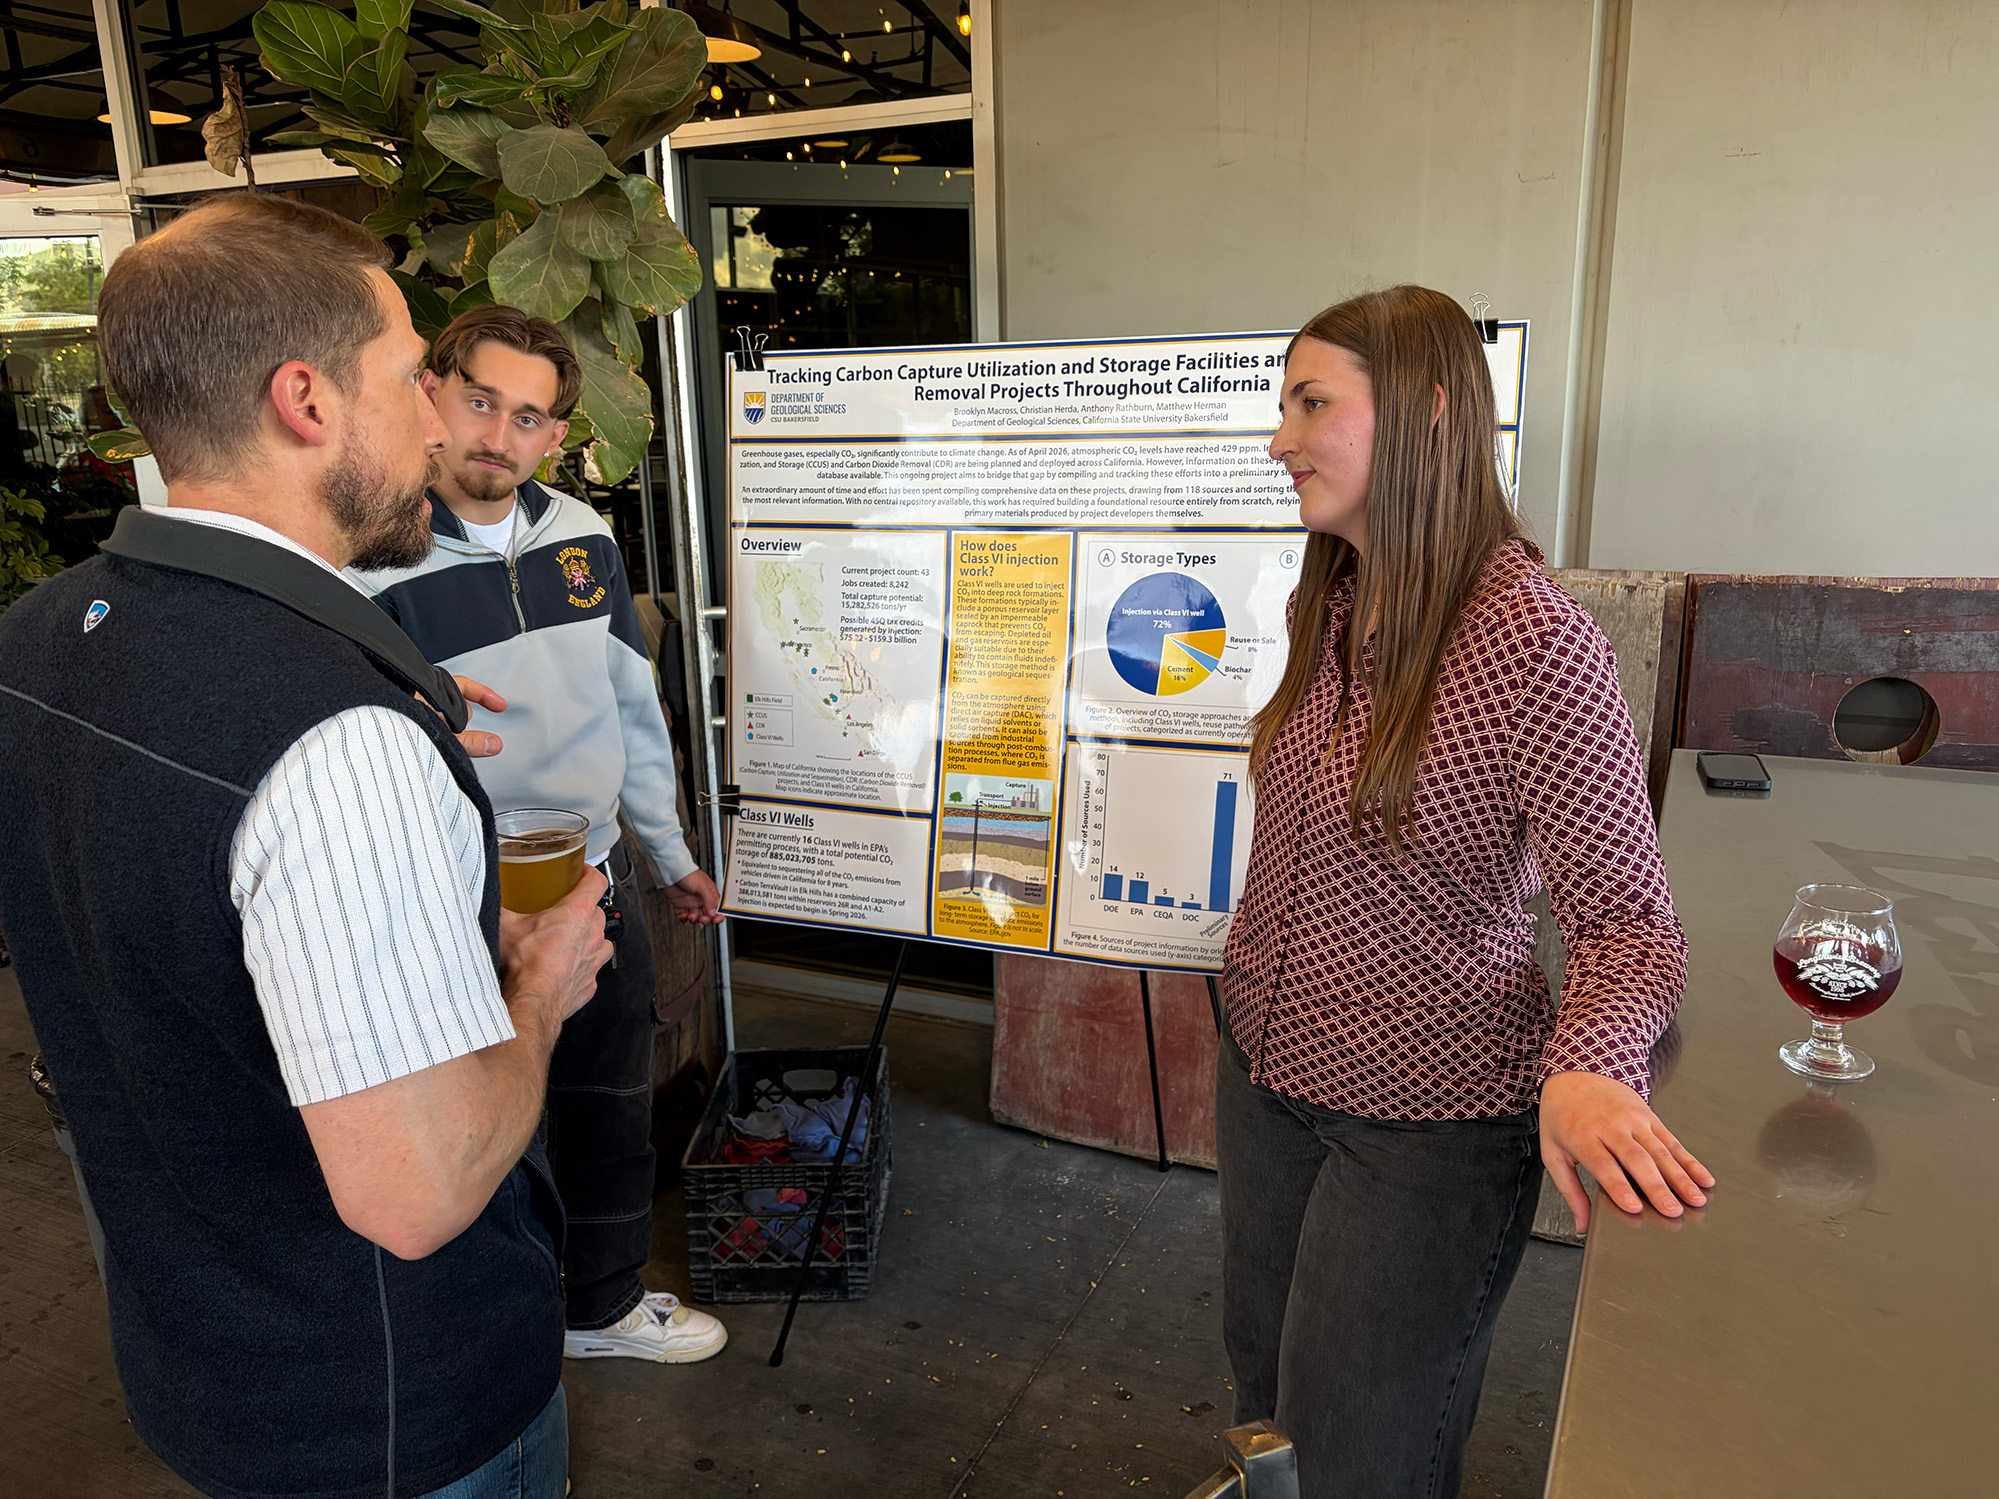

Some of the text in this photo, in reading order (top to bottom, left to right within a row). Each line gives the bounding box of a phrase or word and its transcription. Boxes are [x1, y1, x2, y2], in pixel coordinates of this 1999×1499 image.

[767, 367, 831, 386] Tracking
[835, 366, 893, 382] Carbon
[896, 364, 962, 383] Capture
[966, 360, 1056, 378] Utilization
[1060, 358, 1094, 374] and
[1098, 358, 1170, 375] Storage
[1175, 352, 1259, 370] Facilities
[914, 376, 1270, 401] Removal Projects Throughout California
[770, 392, 825, 403] DEPARTMENT OF
[770, 404, 847, 415] GEOLOGICAL SCIENCES
[953, 402, 1226, 416] Brooklyn Macross, Christian Herda, Anthony Rathburn, Matthew Herman
[952, 413, 1229, 428] Department of Geological Sciences, California State University Bakersfield
[964, 509, 1204, 519] primary materials produced by project developers themselves.
[741, 538, 802, 551] Overview
[960, 540, 1017, 551] How does
[556, 547, 588, 564] LONDON
[960, 552, 1059, 567] Class VI injection
[1103, 554, 1110, 562] A
[1120, 551, 1217, 567] Storage Types
[1286, 554, 1293, 564] B
[841, 566, 930, 577] Current project count: 43
[960, 566, 994, 577] work?
[841, 579, 909, 589] Jobs created: 8,242
[568, 586, 606, 608] ENGLAND
[841, 592, 924, 603] Total capture potential:
[841, 600, 907, 612] 15,282,526 tons/yr
[1121, 608, 1152, 617] Injection
[1152, 608, 1163, 616] via
[1163, 608, 1181, 616] Class
[840, 616, 869, 625] Possible
[886, 617, 898, 626] tax
[898, 618, 924, 626] credits
[1153, 620, 1172, 629] 72%
[839, 625, 922, 636] generated by injection:
[868, 634, 892, 643] $159.3
[893, 635, 917, 644] billion
[1229, 636, 1251, 644] Reuse
[739, 807, 815, 827] Class VI Wells
[737, 828, 756, 838] There
[768, 833, 801, 845] currently
[802, 835, 812, 844] 16
[812, 836, 832, 846] Class
[832, 838, 840, 847] VI
[841, 841, 860, 850] wells
[860, 842, 868, 850] in
[1081, 830, 1087, 838] of
[736, 840, 771, 852] permitting
[771, 844, 801, 854] process,
[802, 846, 819, 855] with
[825, 848, 843, 857] total
[843, 850, 878, 861] potential
[735, 847, 835, 866] storage of 885,023,705 tons.
[740, 869, 762, 878] vehicles
[762, 871, 781, 880] driven
[781, 873, 788, 881] in
[788, 874, 816, 884] California
[816, 877, 826, 885] for
[1103, 905, 1119, 913] DOE
[1130, 908, 1144, 916] EPA
[1153, 911, 1174, 920] CEQA
[1182, 914, 1199, 922] DOC
[1200, 914, 1228, 937] Preliminary
[1208, 922, 1228, 938] Sources
